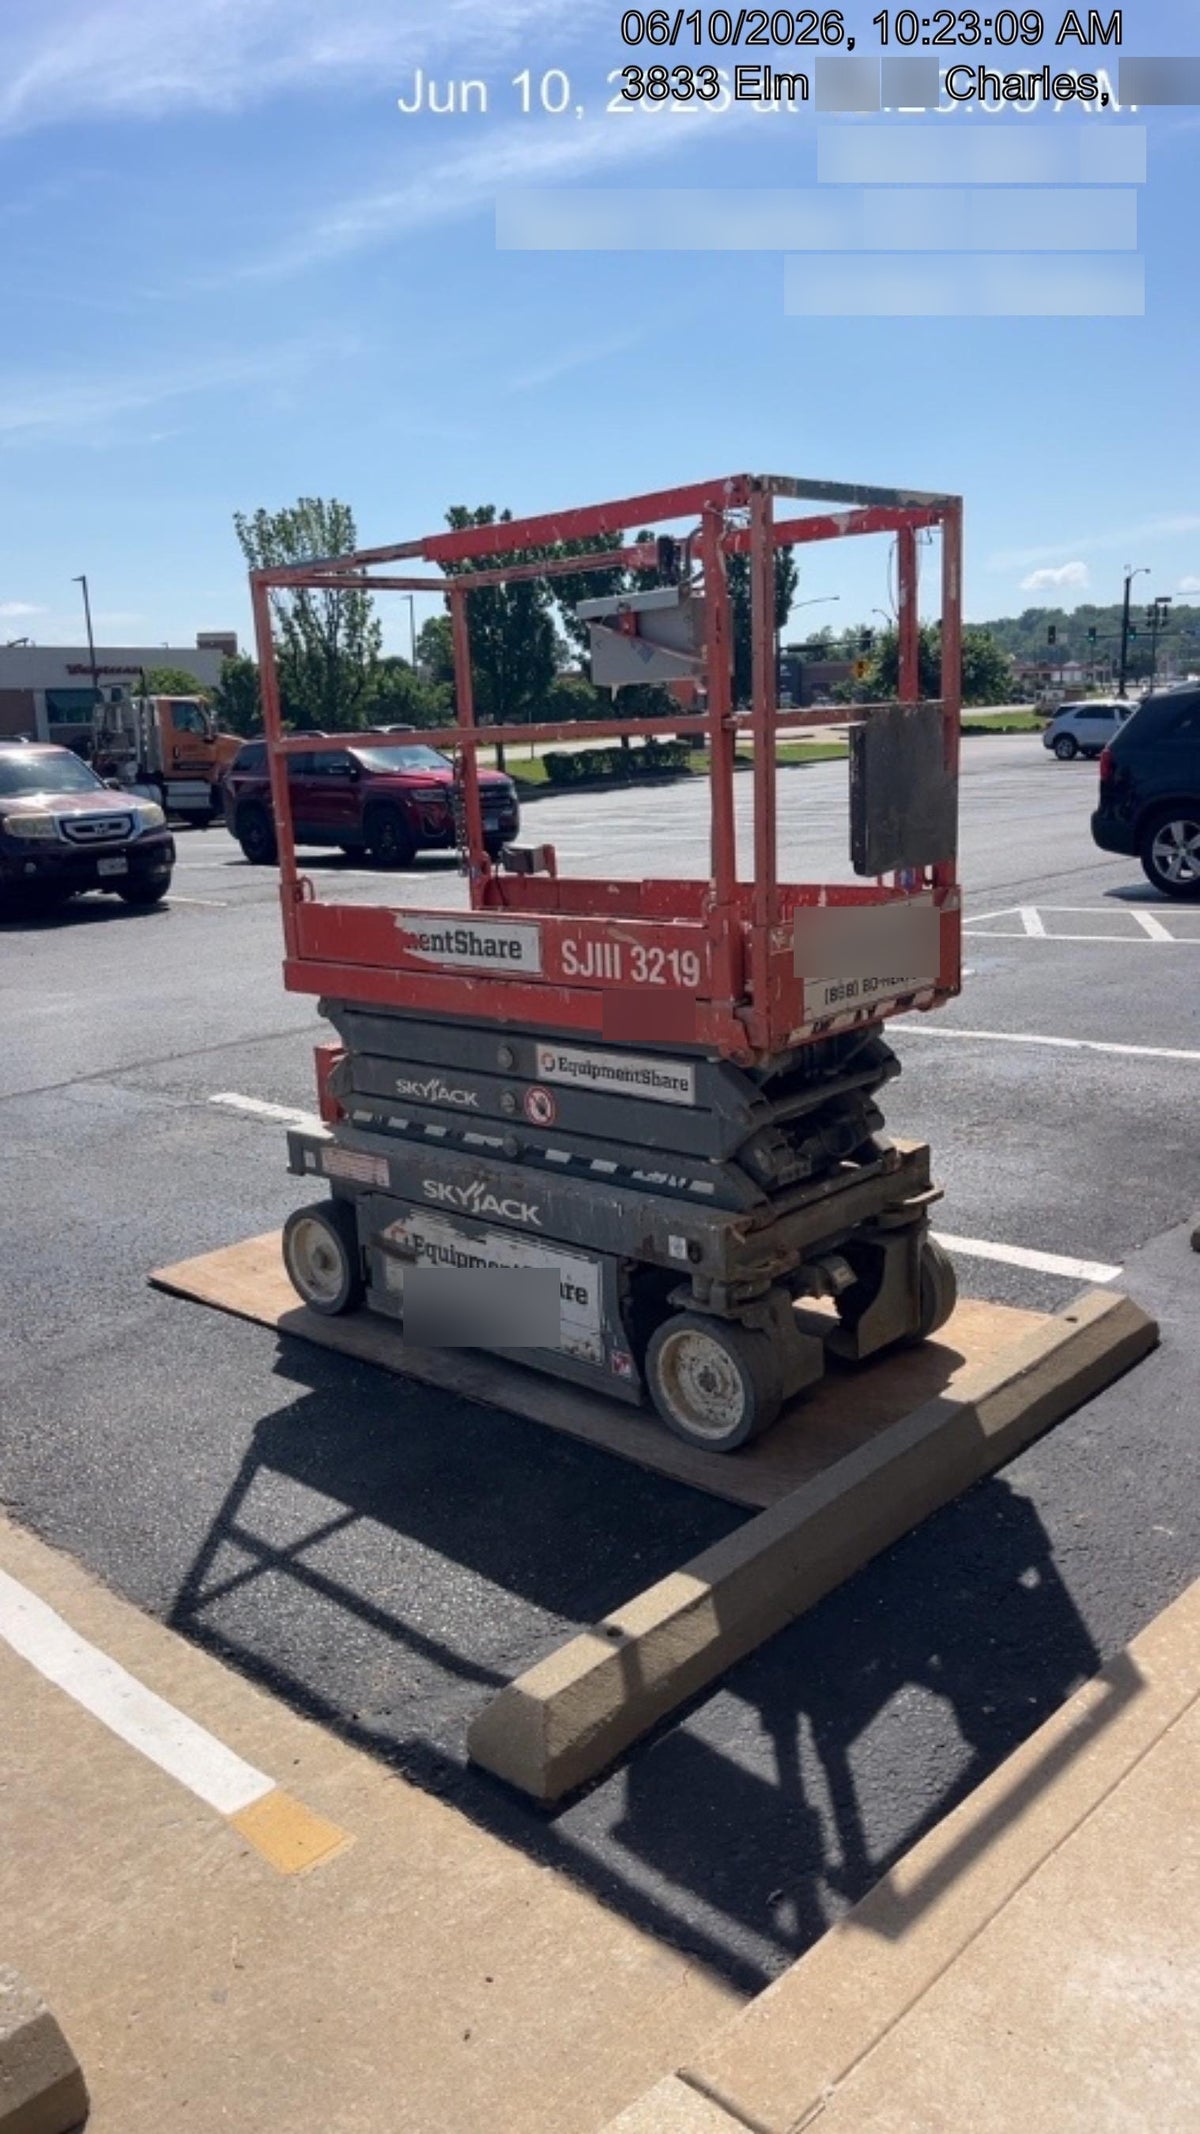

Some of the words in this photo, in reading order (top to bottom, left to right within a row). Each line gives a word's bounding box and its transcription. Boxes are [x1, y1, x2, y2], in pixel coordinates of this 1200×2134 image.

[630, 945, 699, 987] 3219
[395, 1078, 479, 1108] SKYJACK
[558, 1056, 689, 1092] EquipmentShare
[421, 1179, 543, 1227] SKYJACK
